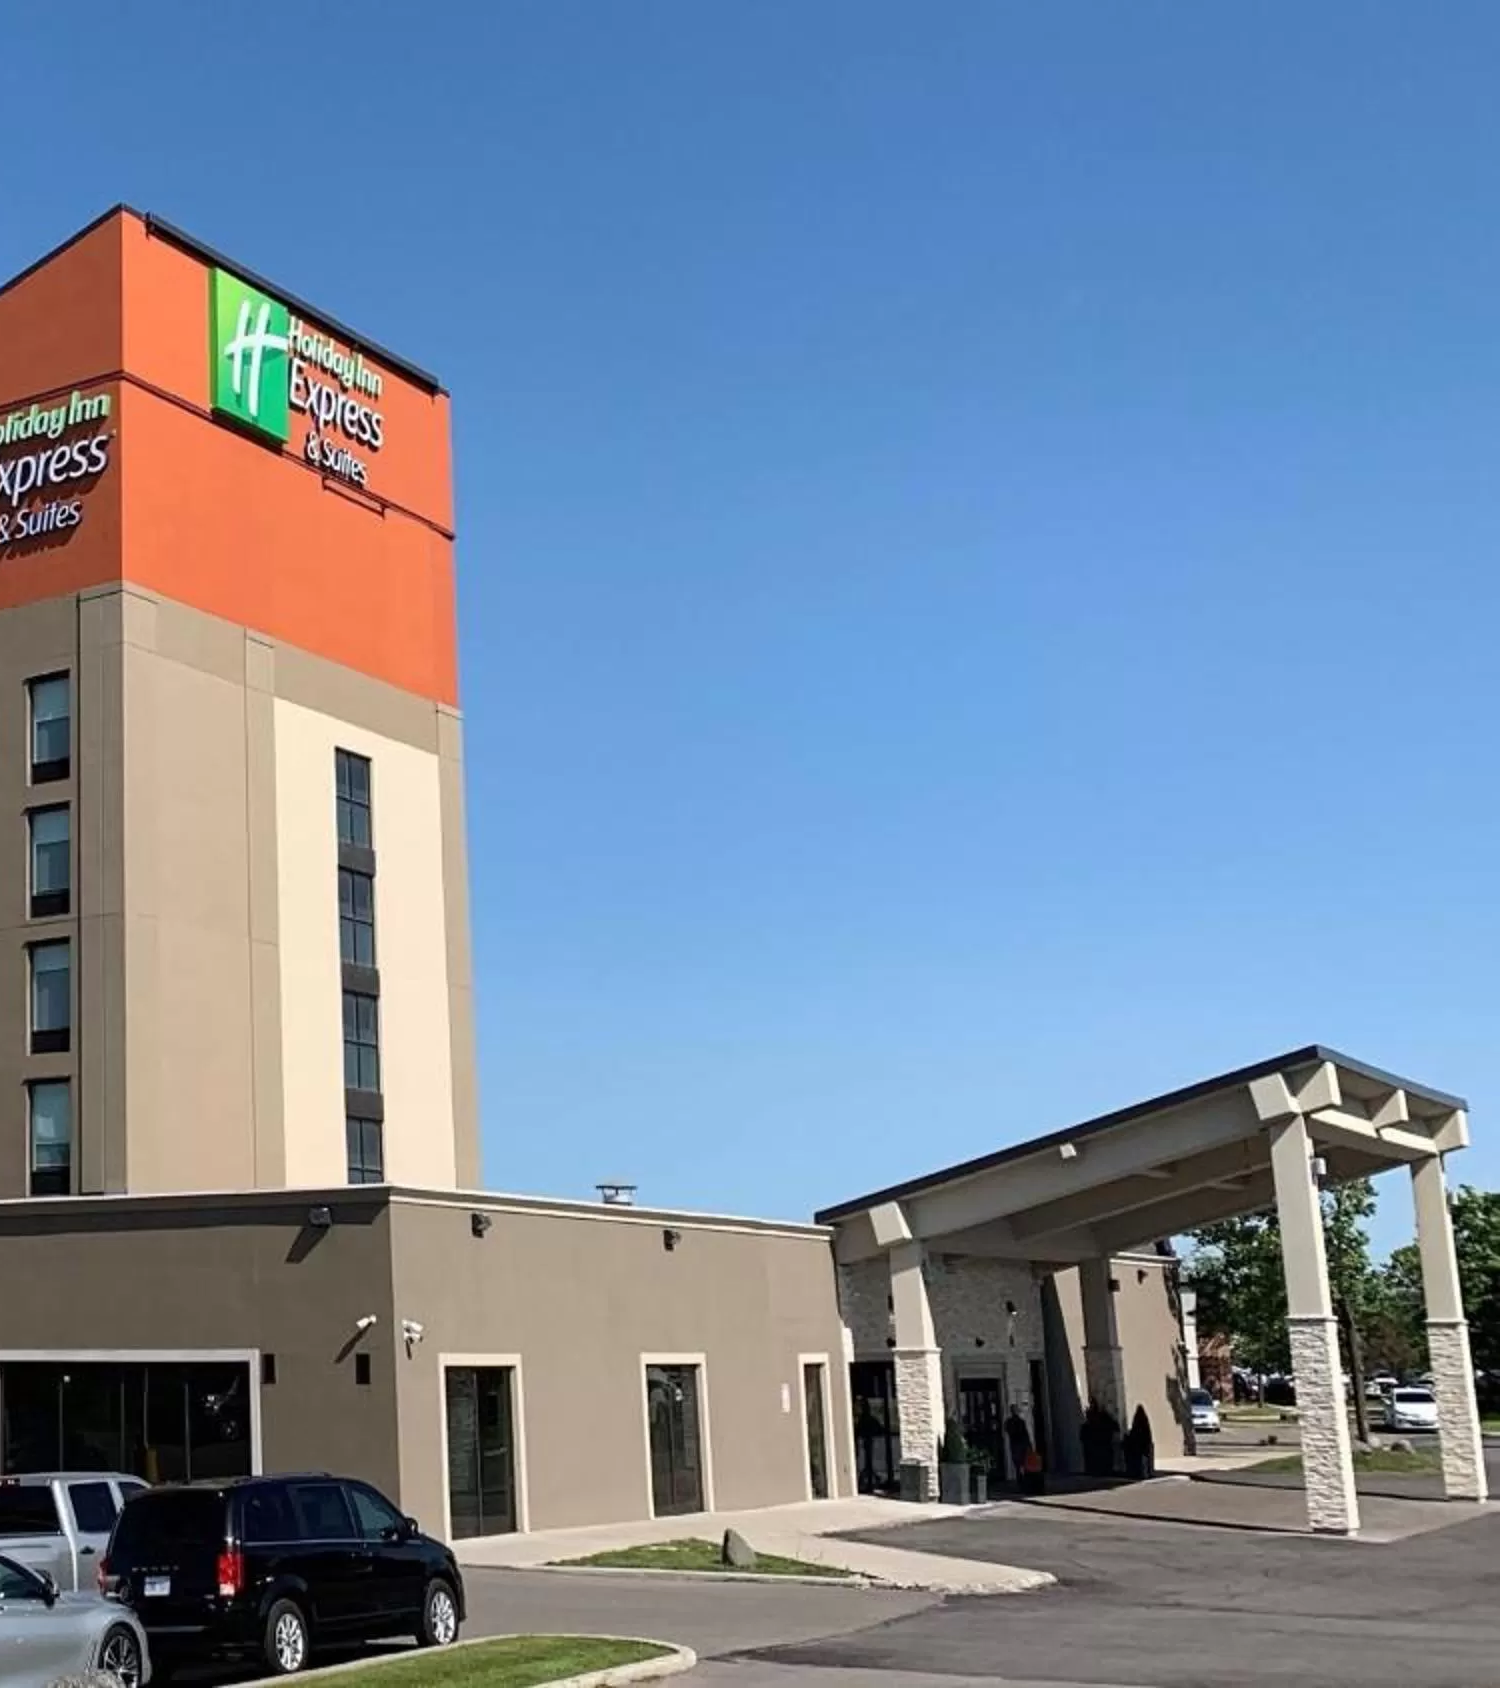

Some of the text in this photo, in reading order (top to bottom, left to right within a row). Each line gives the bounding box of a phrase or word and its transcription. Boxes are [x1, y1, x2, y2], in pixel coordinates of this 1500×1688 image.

[289, 315, 382, 396] Holiday Inn
[68, 390, 111, 425] Inn
[289, 358, 384, 448] Express
[307, 431, 368, 484] & Suites
[15, 501, 82, 539] Suites
